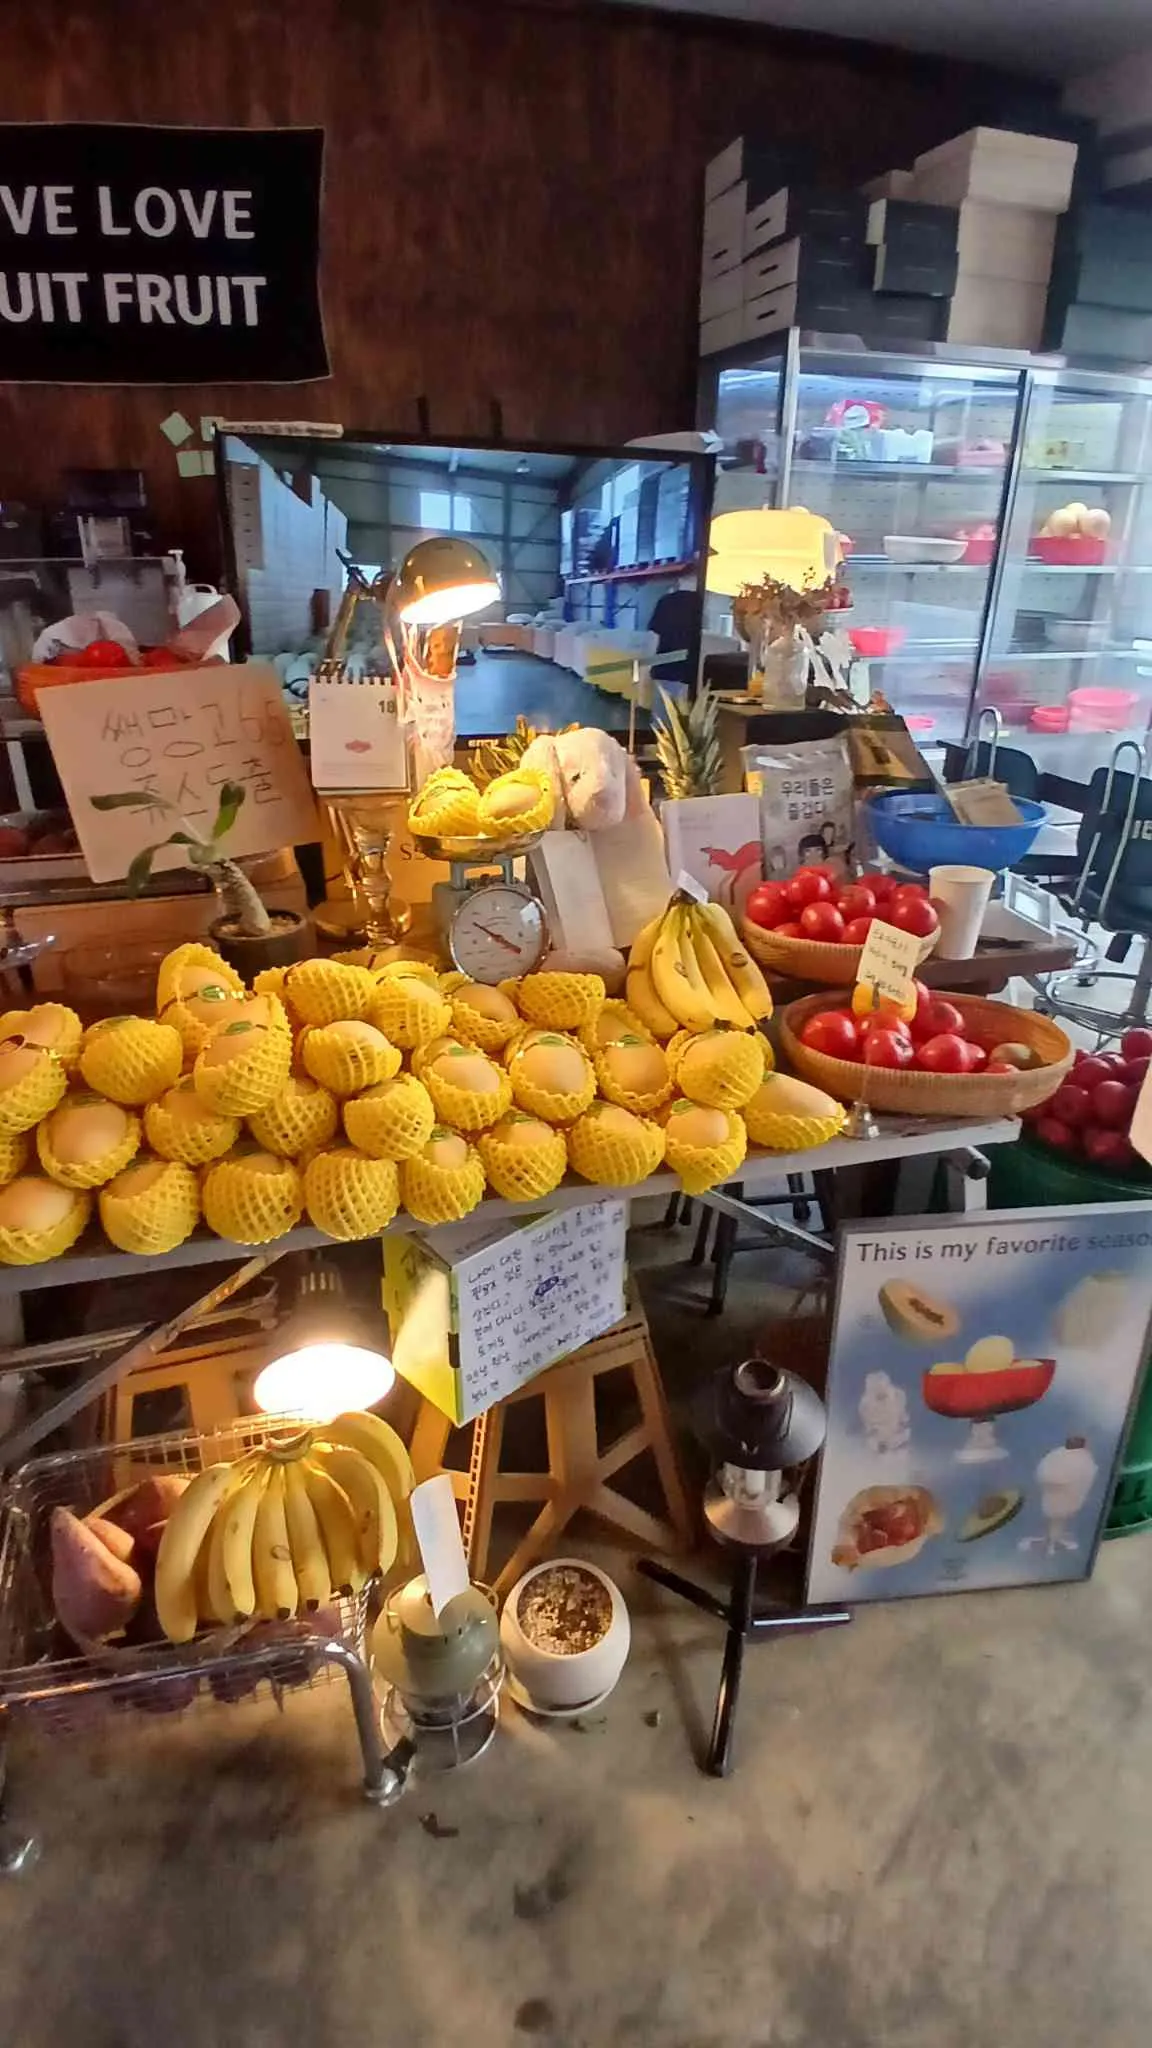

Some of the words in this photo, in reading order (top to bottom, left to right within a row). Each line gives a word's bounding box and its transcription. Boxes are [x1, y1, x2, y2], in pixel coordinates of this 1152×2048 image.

[98, 185, 255, 239] LOVE
[103, 272, 267, 326] FRUIT
[857, 1242, 907, 1262] This
[915, 1240, 933, 1260] is
[941, 1243, 978, 1263] my
[986, 1234, 1080, 1256] favorite
[1087, 1231, 1152, 1250] seaso
